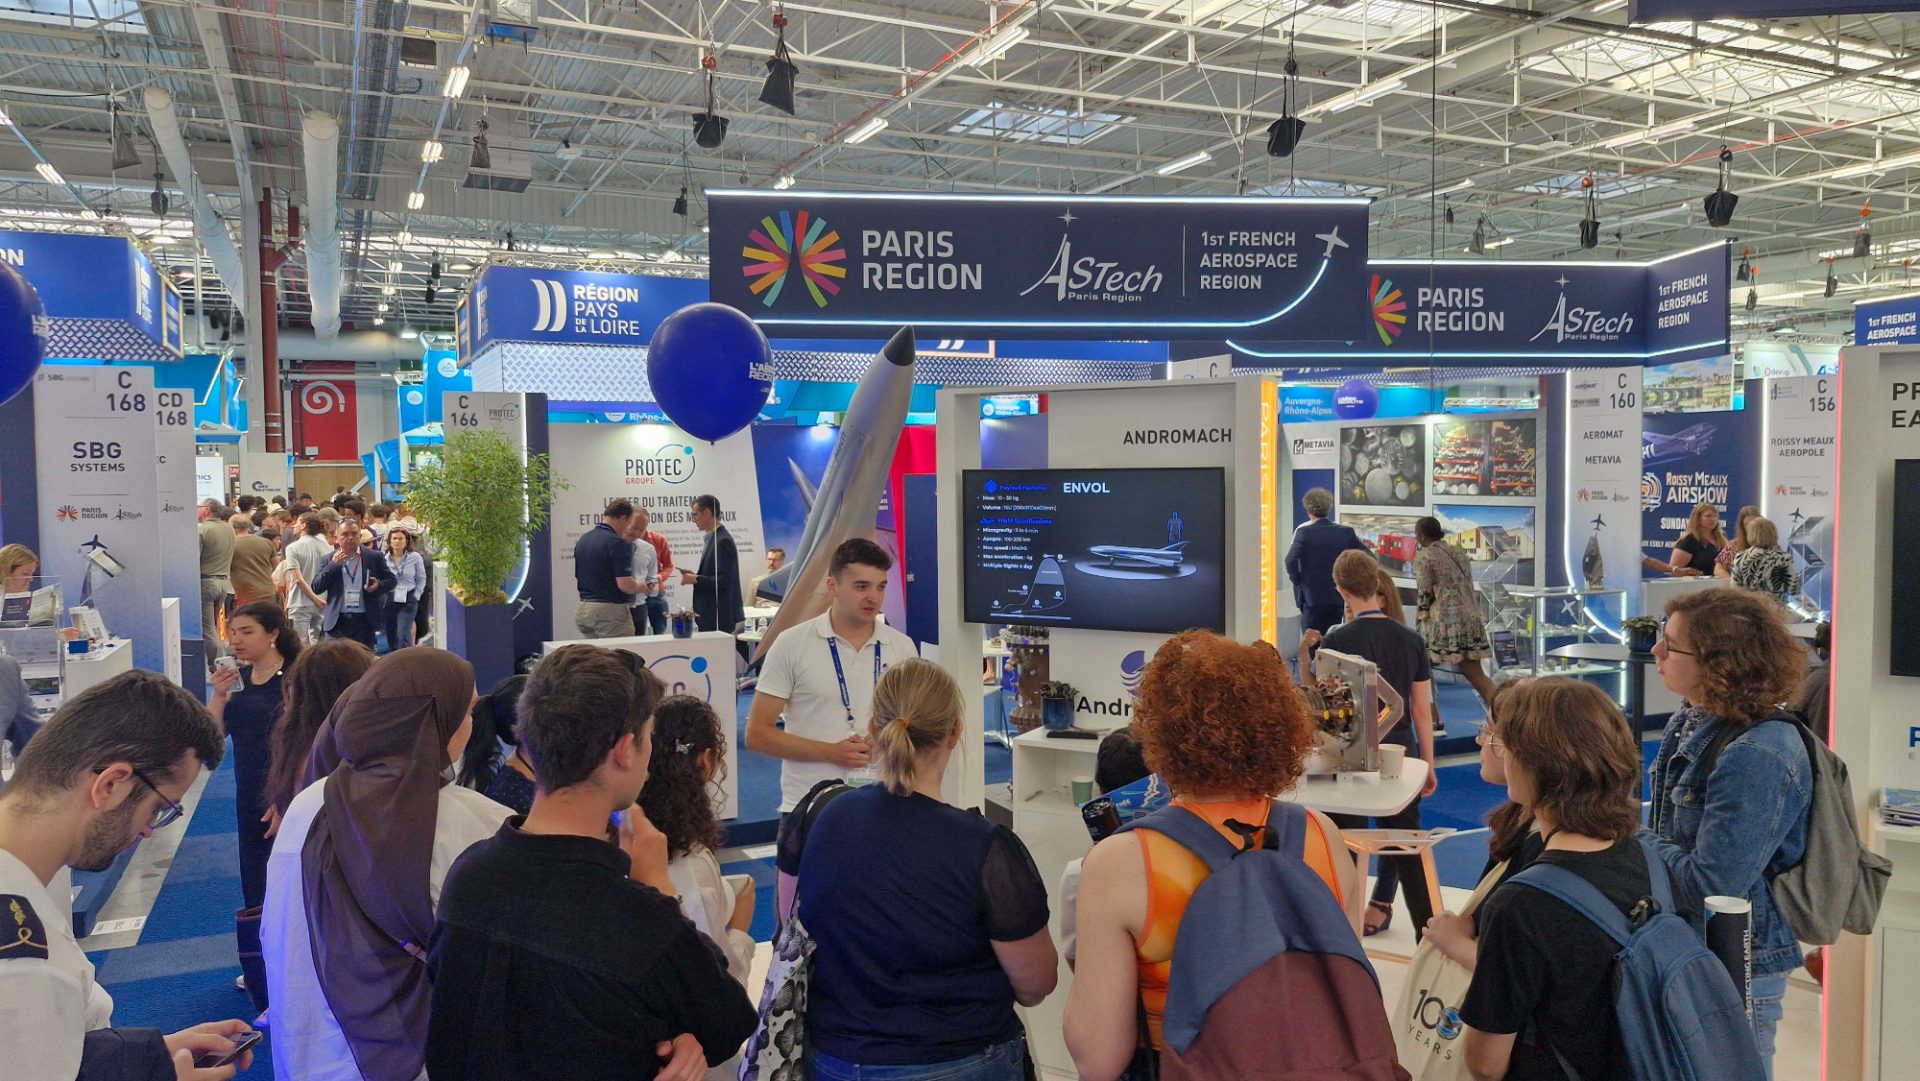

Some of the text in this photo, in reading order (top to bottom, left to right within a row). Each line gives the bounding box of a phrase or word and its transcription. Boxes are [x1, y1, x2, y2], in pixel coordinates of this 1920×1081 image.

[862, 229, 954, 260] PARIS
[1201, 231, 1297, 247] 1ST FRENCH
[1020, 233, 1163, 302] ASTech
[1200, 253, 1298, 269] AEROSPACE
[862, 262, 982, 291] REGION
[1200, 275, 1262, 290] REGION
[1658, 273, 1708, 297] 1ST FRENCH
[573, 284, 640, 303] RÉGION
[1068, 292, 1142, 303] Paris Region
[1417, 287, 1484, 309] PARIS
[1658, 290, 1709, 313] AEROSPACE
[574, 302, 618, 318] PAYS
[1530, 292, 1634, 343] ASTech
[575, 318, 587, 326] DE
[1417, 311, 1504, 332] REGION
[1658, 312, 1690, 329] REGION
[1868, 312, 1916, 327] 1ST FRENCH
[591, 320, 640, 336] LOIRE
[1867, 325, 1917, 340] AEROSPACE
[1590, 334, 1619, 342] Region
[118, 371, 132, 389] C
[1617, 373, 1627, 389] C
[1817, 379, 1828, 394] C
[107, 393, 146, 412] 168
[158, 392, 183, 407] CD
[459, 396, 469, 409] C
[1285, 397, 1325, 406] Auvergne-
[1610, 392, 1635, 409] 160
[1809, 397, 1836, 412] 156
[156, 411, 187, 426] 168
[1285, 406, 1333, 416] Rhône-Alpes
[451, 412, 479, 427] 166
[1123, 428, 1233, 445] ANDROMACH
[1583, 430, 1624, 440] AEROMAT
[1771, 436, 1835, 446] ROISSY MEAUX
[73, 442, 121, 459] SBG
[1304, 440, 1335, 449] METAVIA
[1779, 448, 1825, 457] AEROPOLE
[70, 463, 125, 472] SYSTEMS
[625, 458, 682, 476] PROTEC
[1585, 455, 1622, 465] METAVIA
[625, 477, 655, 485] GROUPE
[1666, 471, 1728, 486] ROISSY MEAUX
[1063, 482, 1111, 493] ENVOL
[1666, 487, 1728, 504] AIRSHOW
[642, 496, 655, 508] DU
[657, 495, 700, 507] TRAITEM
[580, 514, 591, 526] ET
[667, 510, 683, 523] DES
[1076, 696, 1134, 716] Andr
[1408, 1023, 1453, 1061] YEARS
